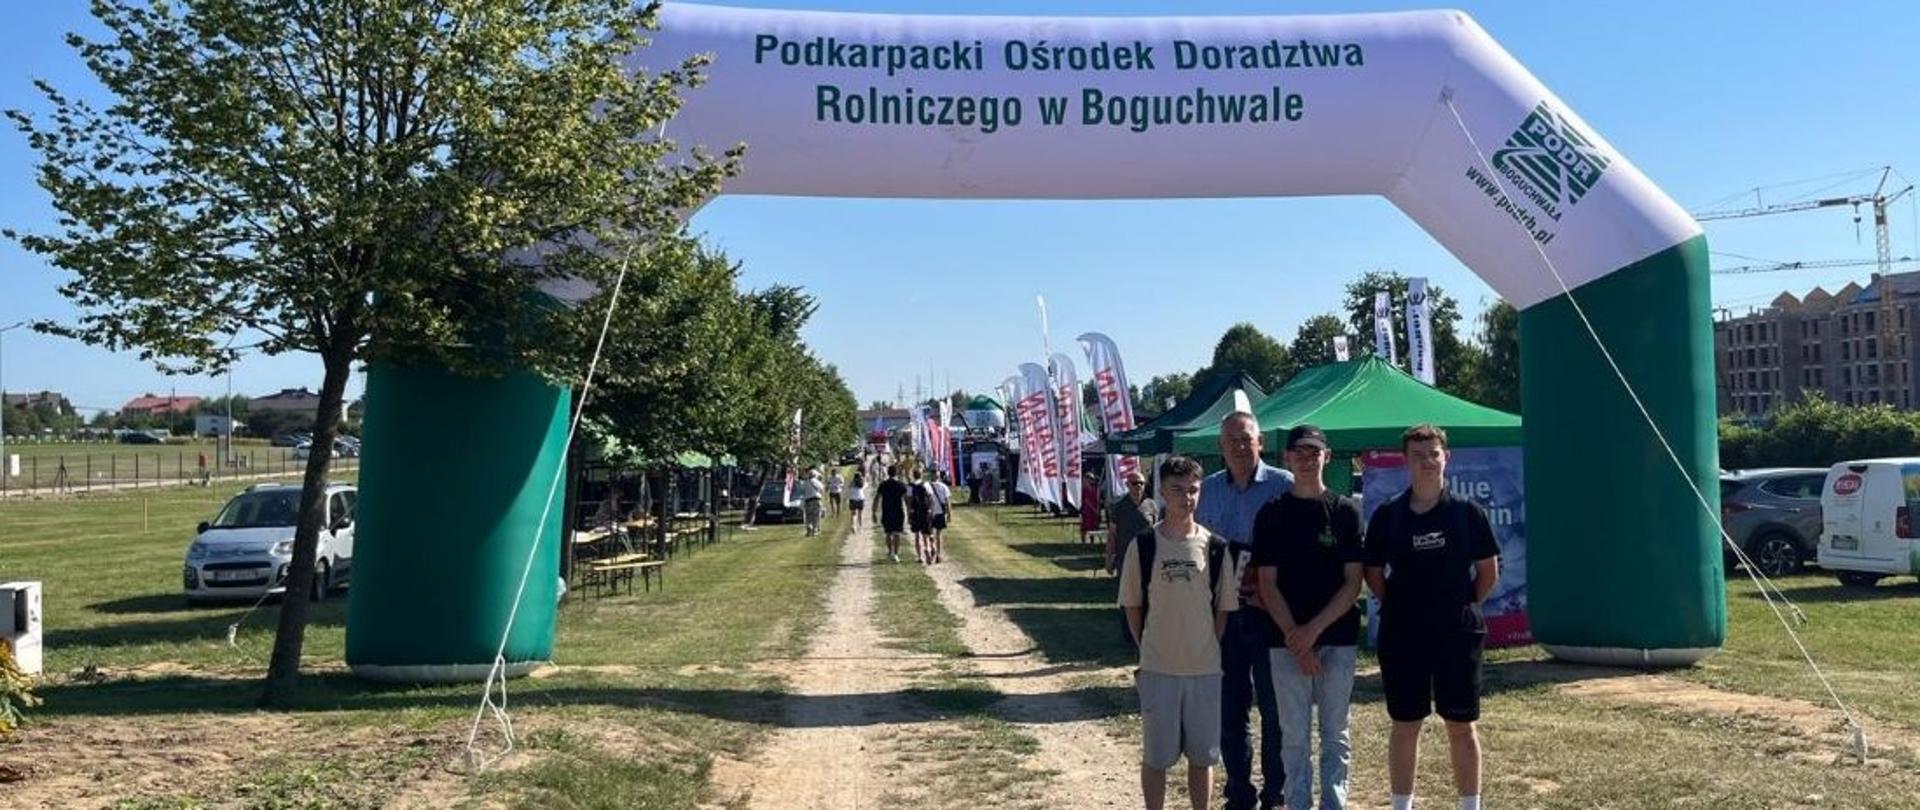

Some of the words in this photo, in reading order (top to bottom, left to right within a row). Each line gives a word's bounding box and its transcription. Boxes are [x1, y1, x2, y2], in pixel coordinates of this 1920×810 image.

[754, 33, 983, 77] Podkarpacki
[1003, 39, 1156, 71] Ośrodek
[1172, 39, 1365, 70] Doradztwa
[816, 84, 1022, 134] Rolniczego
[1037, 96, 1069, 126] w
[1081, 86, 1304, 133] Boguchwale
[1527, 117, 1593, 182] PODR
[1500, 163, 1562, 222] BOGUCHWAŁA
[1445, 475, 1491, 499] lue
[1482, 502, 1511, 525] in
